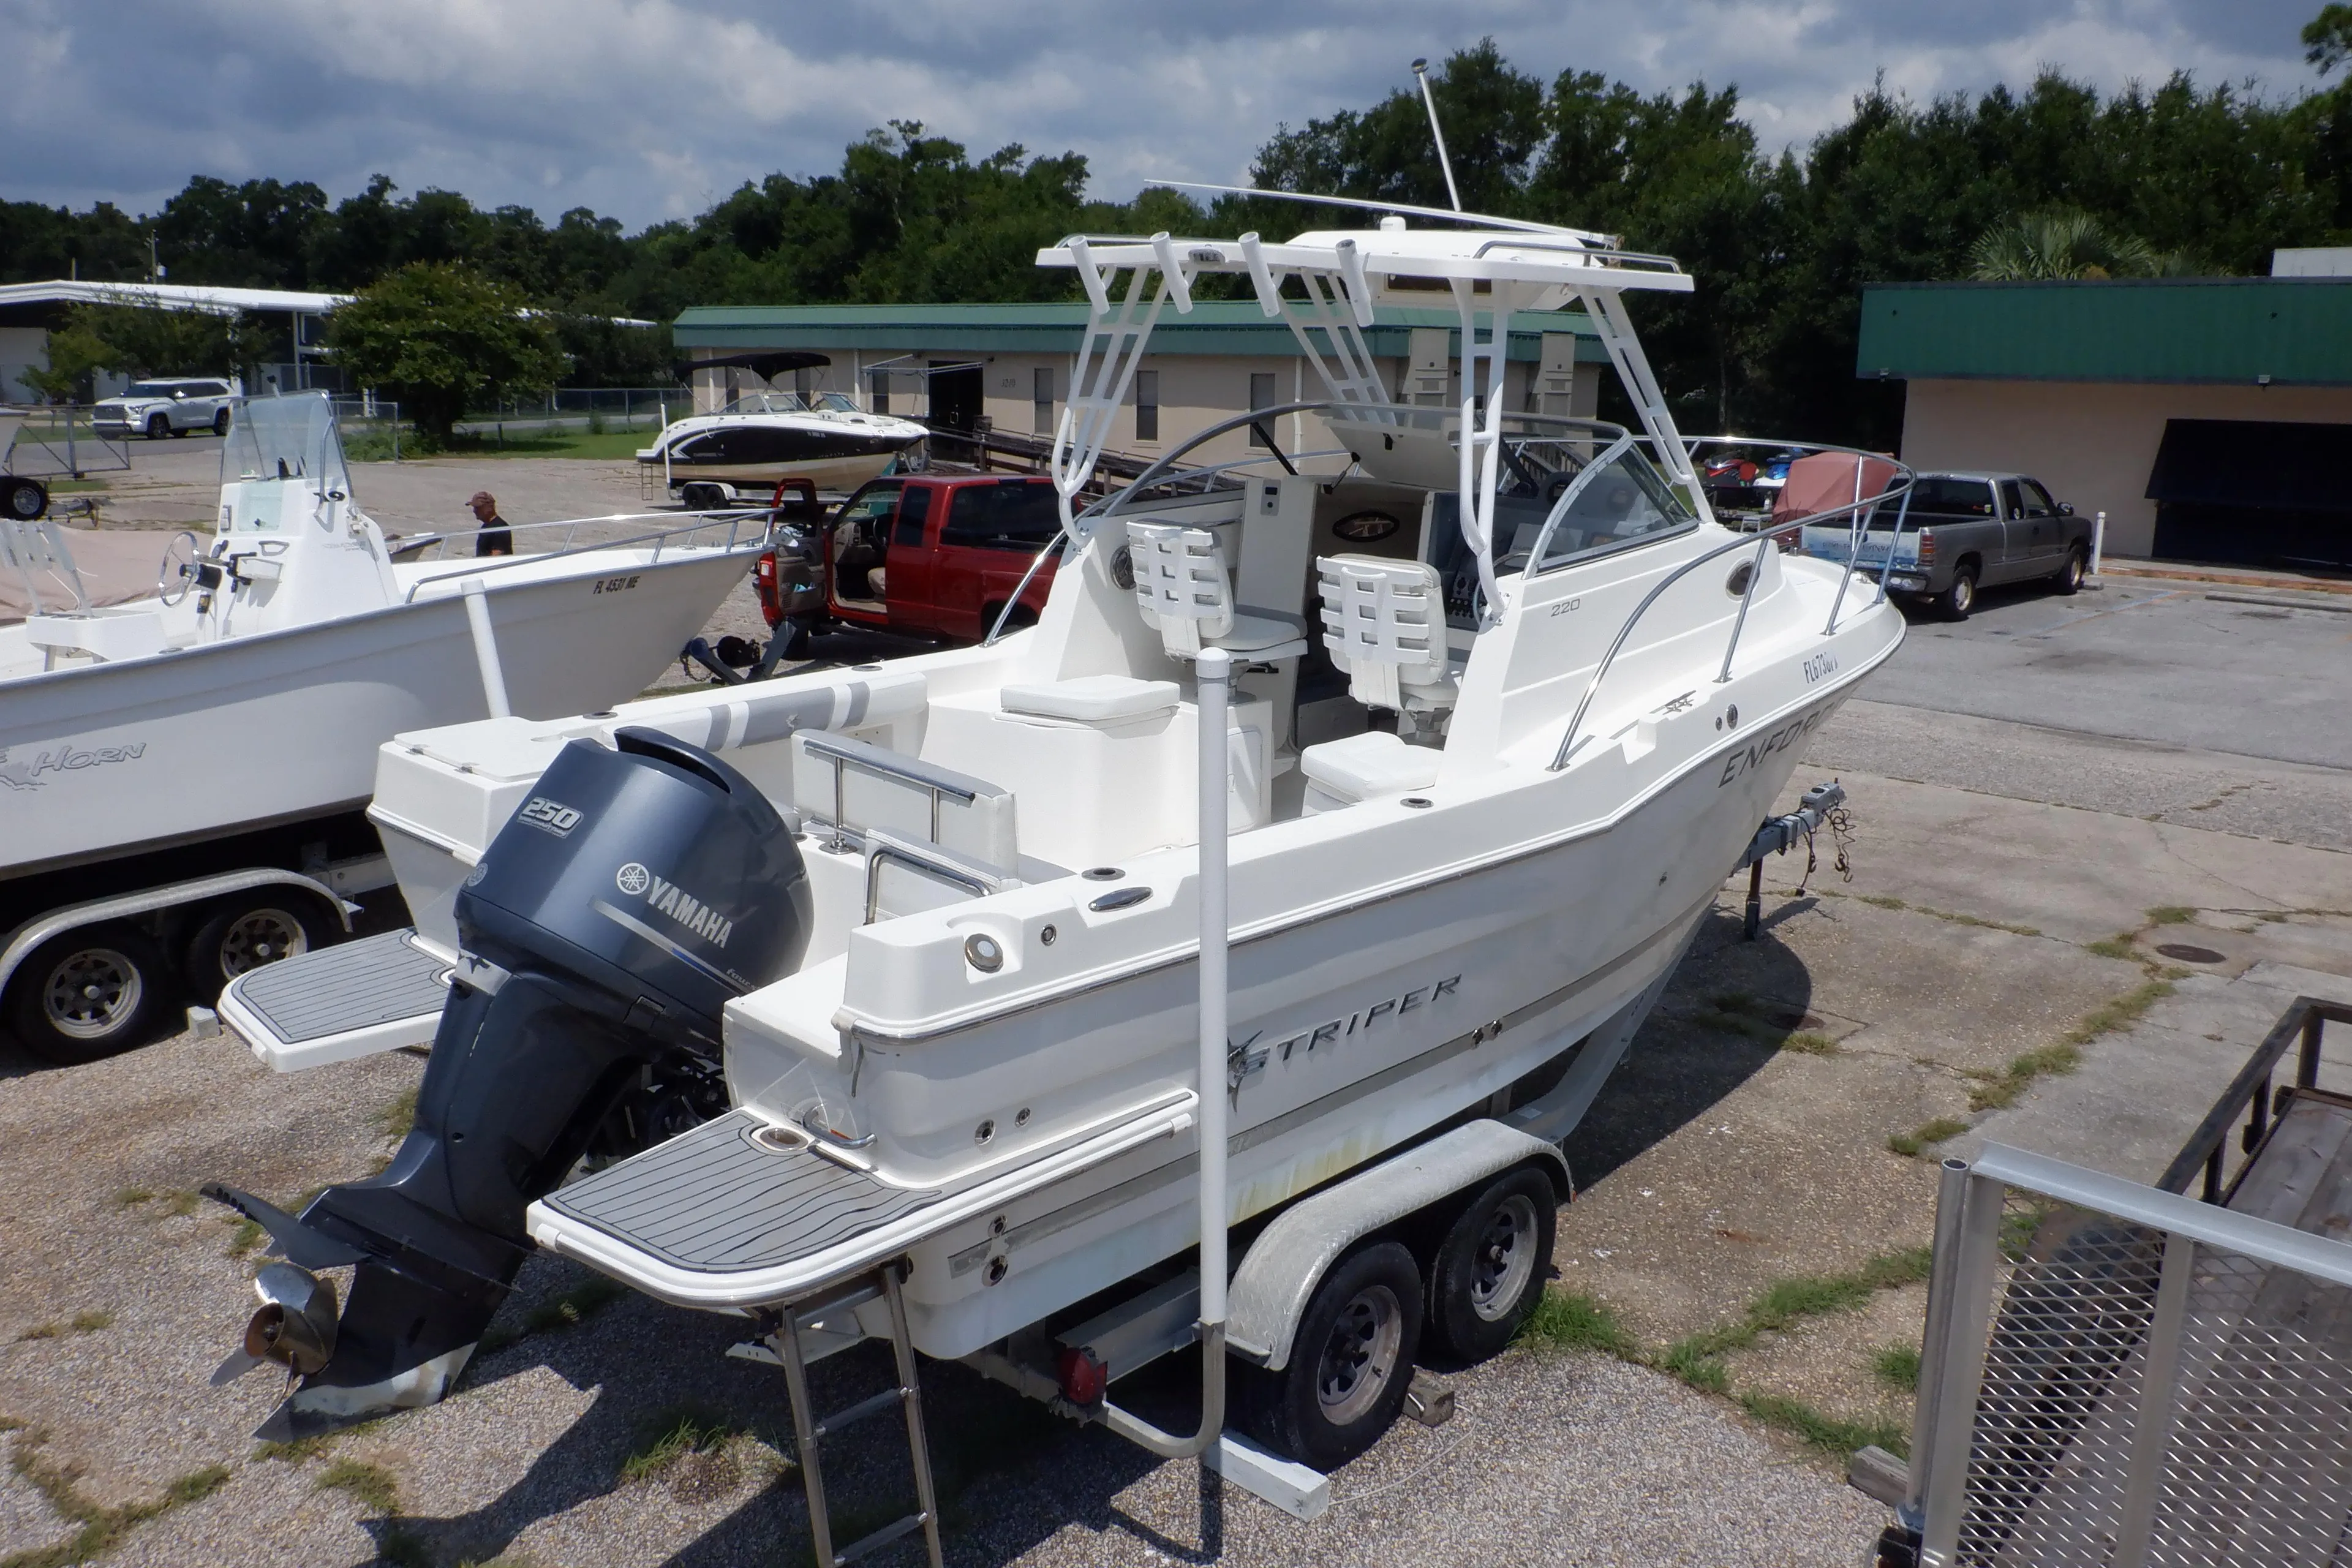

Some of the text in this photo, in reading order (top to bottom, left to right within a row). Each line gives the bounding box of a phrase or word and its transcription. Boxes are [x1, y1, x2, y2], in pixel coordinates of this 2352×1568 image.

[593, 580, 604, 595] FL
[1551, 598, 1580, 617] 220
[31, 742, 146, 777] HORN
[521, 798, 581, 831] 250
[647, 875, 733, 949] YAMAHA
[1242, 973, 1462, 1077] STRIPER
